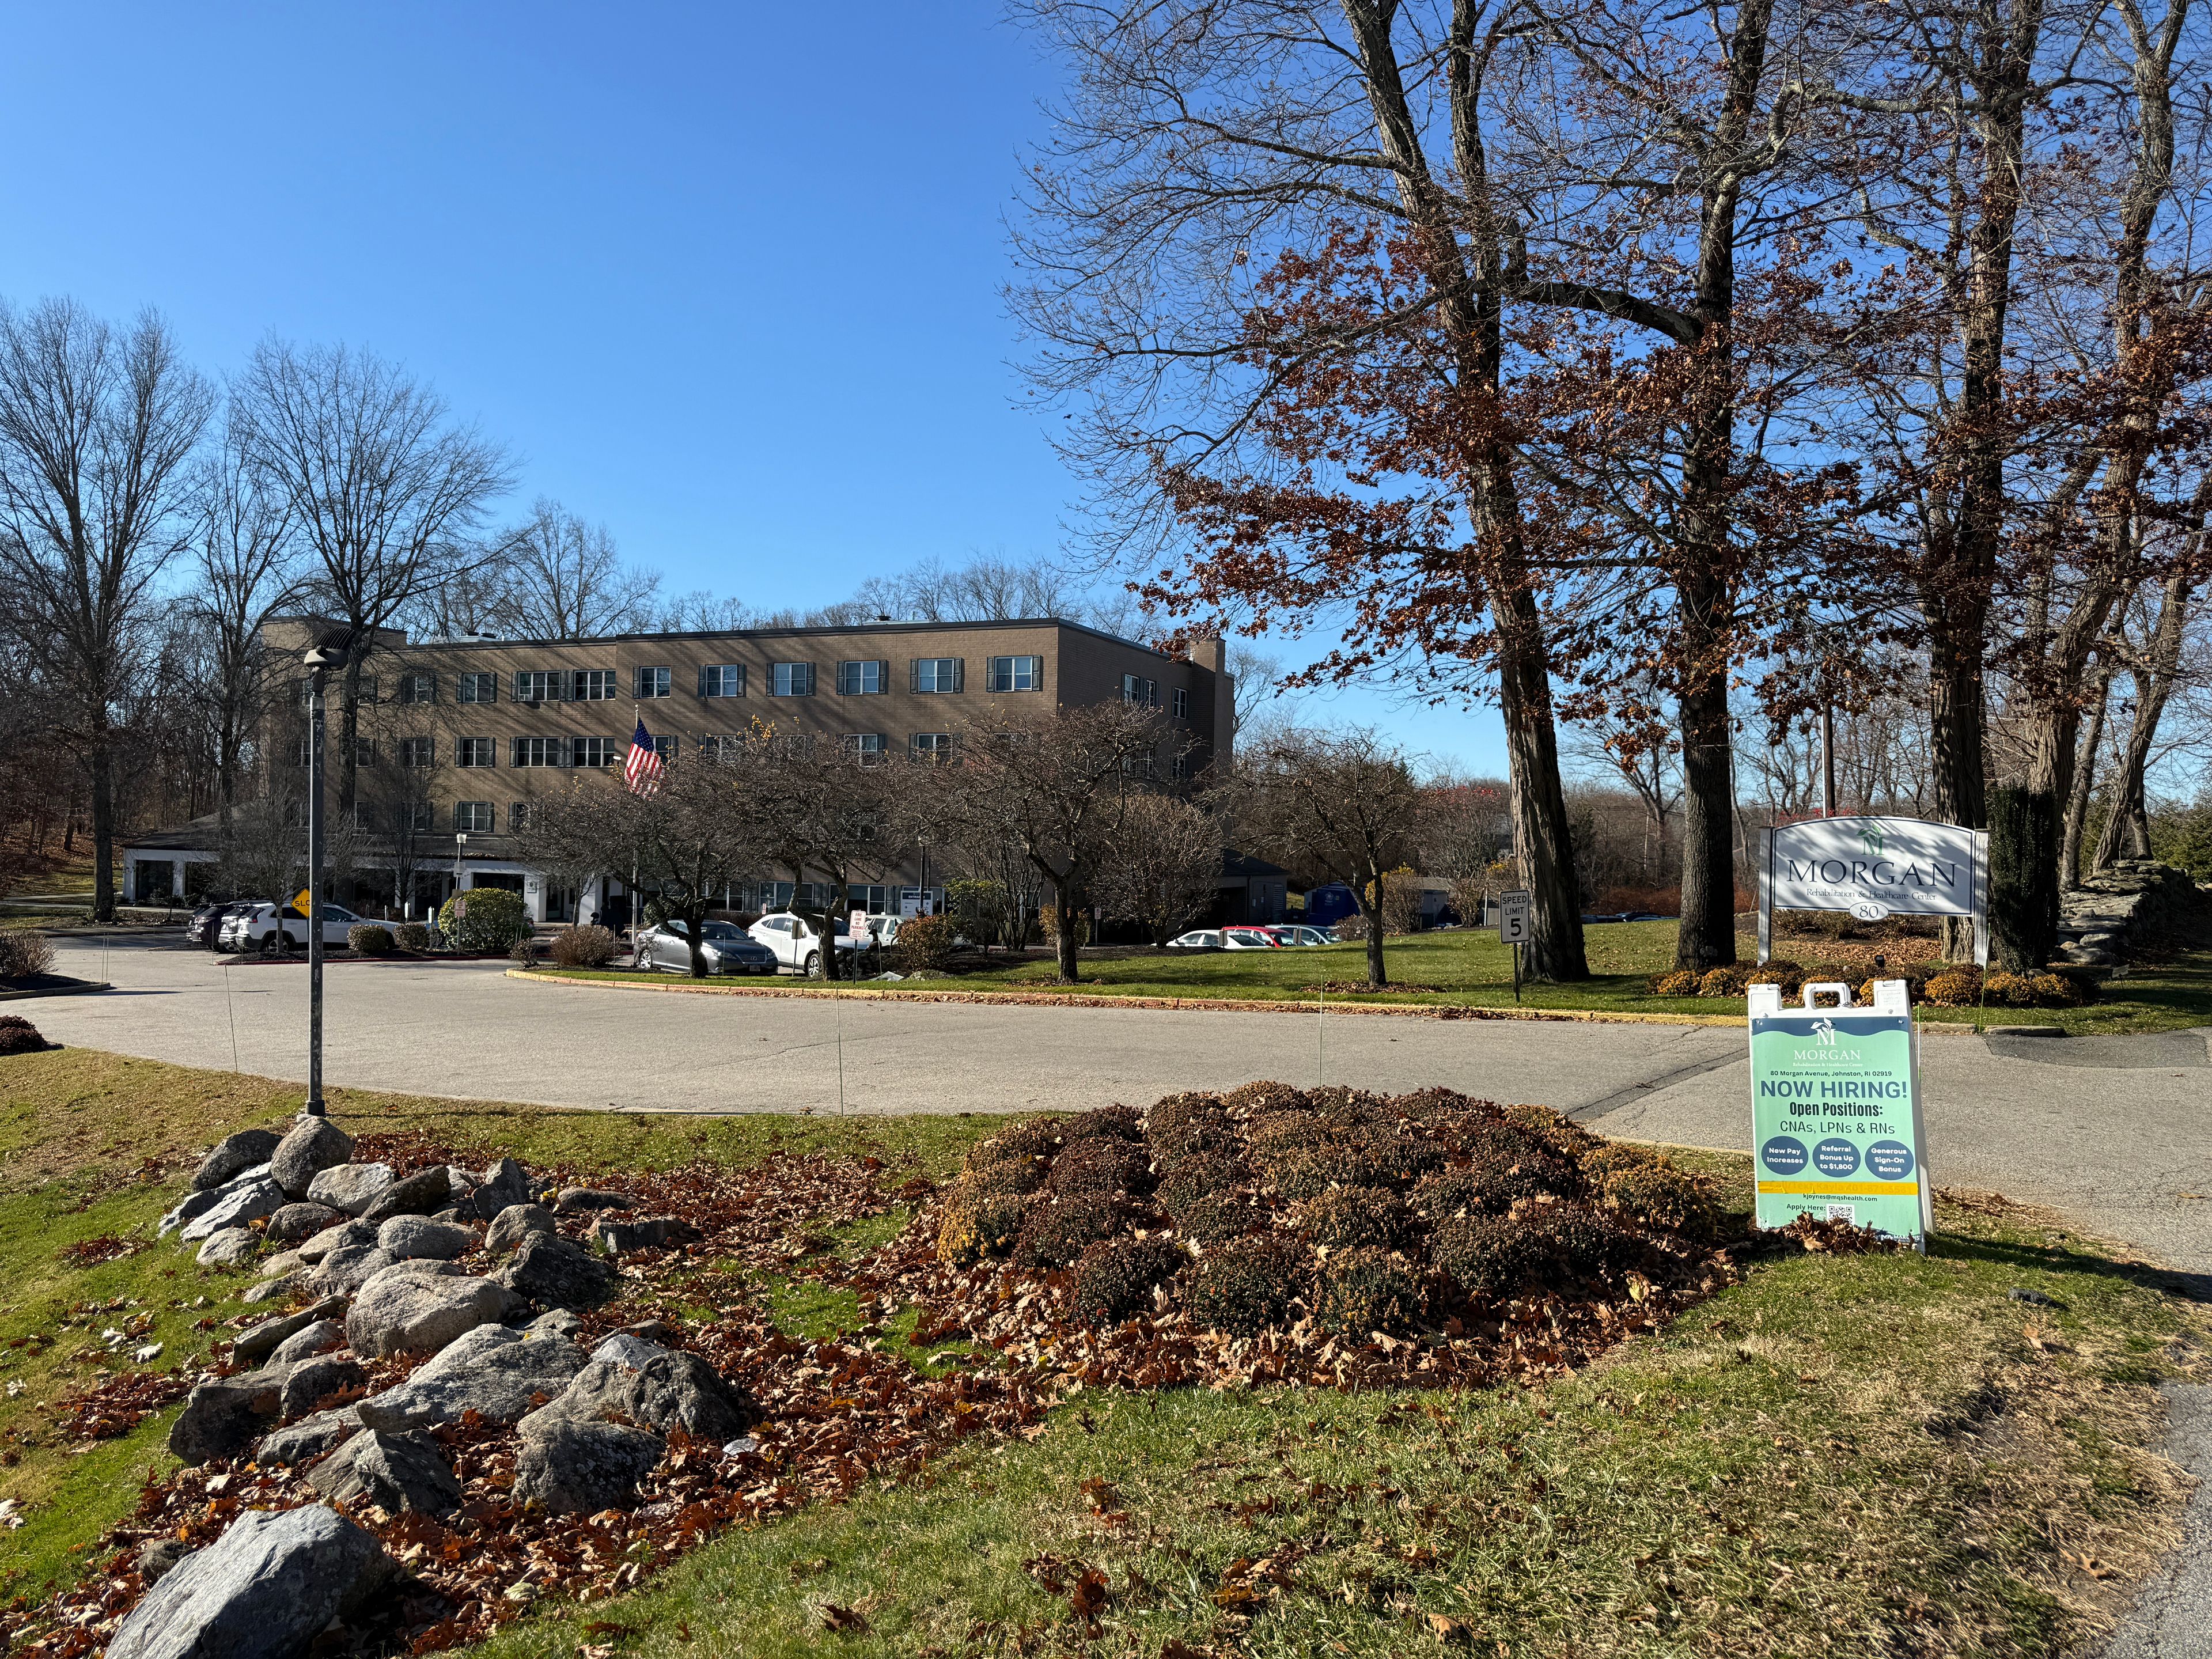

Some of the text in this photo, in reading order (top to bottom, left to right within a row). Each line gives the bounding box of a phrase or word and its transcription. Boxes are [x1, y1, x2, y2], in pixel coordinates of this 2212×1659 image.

[1786, 859, 1958, 888] MORGAN
[1502, 896, 1527, 904] SPEED
[1806, 888, 1855, 897] Rehabilitation
[1869, 891, 1908, 899] Healthcare
[1911, 892, 1937, 900] Center
[1505, 907, 1524, 915] LIMIT
[1859, 905, 1879, 918] 80
[1510, 918, 1521, 937] 5
[1793, 1050, 1861, 1060] MORGAN
[1761, 1080, 1907, 1099] NOW HIRING!
[1790, 1101, 1883, 1117] Open Positions:
[1780, 1121, 1895, 1134] CNAs, LPNs & RNs
[1803, 1194, 1877, 1202] kjoynes@mqshealth.com
